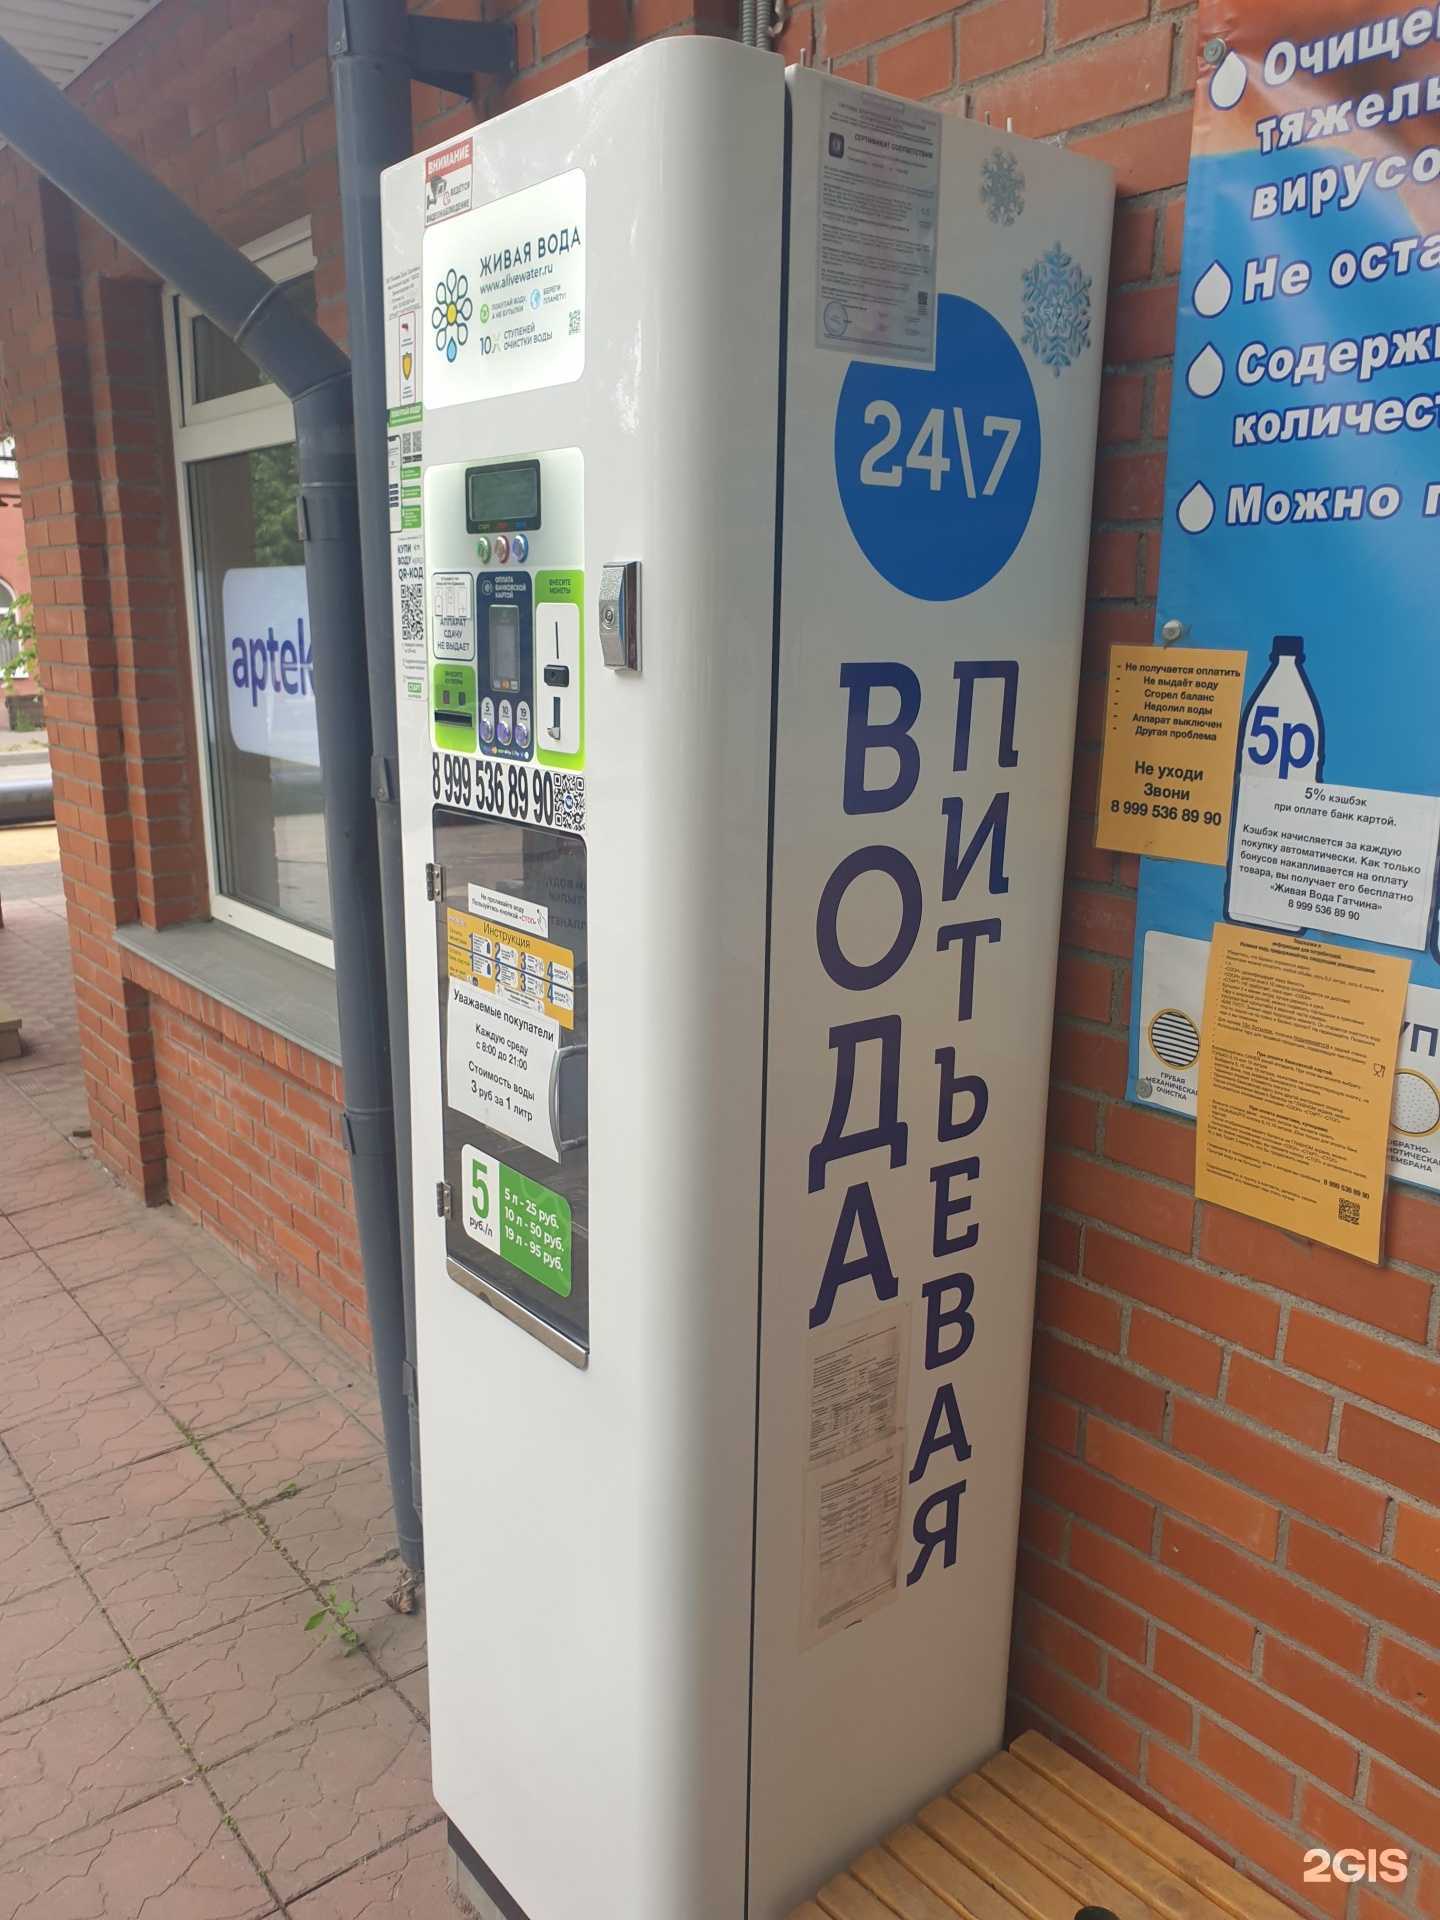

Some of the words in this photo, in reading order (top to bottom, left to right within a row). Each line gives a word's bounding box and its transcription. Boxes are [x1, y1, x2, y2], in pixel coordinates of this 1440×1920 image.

[428, 144, 470, 175] ВНИМАНИЕ
[480, 242, 530, 278] ЖИВАЯ
[538, 227, 581, 257] ВОДА
[480, 263, 553, 294] www.alivewater.ru
[1244, 256, 1310, 302] Не
[504, 321, 535, 339] СТУПЕНЕЙ
[504, 336, 532, 351] ОЧИСТКИ
[533, 331, 552, 343] ВОДЫ
[1233, 395, 1440, 445] количес
[1226, 484, 1400, 524] Можно
[440, 618, 467, 627] АППАРАТ
[443, 630, 462, 639] СДАЧУ
[446, 642, 470, 651] ВЫДАЕТ
[1125, 662, 1137, 672] Не
[1139, 664, 1194, 674] получается
[1196, 667, 1241, 678] оплатить
[1143, 676, 1155, 685] Не
[1196, 681, 1219, 691] воду
[1144, 688, 1178, 699] Сгорел
[1181, 691, 1214, 702] баланс
[1132, 714, 1171, 725] Аппарат
[1173, 718, 1222, 729] выключен
[1187, 706, 1213, 716] воды
[1135, 726, 1168, 737] Другая
[1170, 730, 1217, 741] проблема
[1247, 705, 1316, 780] 5р
[1135, 761, 1154, 775] Не
[1157, 766, 1204, 781] уходи
[433, 752, 441, 800] 8
[444, 754, 472, 807] 999
[476, 760, 505, 815] 536
[508, 765, 528, 820] 89
[533, 769, 554, 826] 90
[1144, 783, 1190, 801] Звони
[1304, 787, 1326, 801] 5%
[1328, 792, 1367, 807] кэшбэк
[1110, 800, 1120, 813] 8
[1123, 801, 1148, 816] 999
[1151, 805, 1178, 820] 536
[1181, 809, 1199, 823] 89
[1204, 812, 1222, 826] 90
[1274, 802, 1292, 815] при
[1293, 805, 1328, 817] оплате
[1330, 809, 1354, 821] банк
[1356, 814, 1397, 827] картой.
[1243, 824, 1278, 838] Кэшбэк
[1281, 832, 1343, 848] начисляется
[1345, 840, 1357, 850] за
[1360, 843, 1402, 857] каждую
[1240, 851, 1278, 864] бонусов
[1280, 859, 1354, 877] накапливается
[1356, 871, 1368, 880] на
[1372, 874, 1408, 888] оплату
[1241, 839, 1278, 853] покупку
[1280, 845, 1357, 864] автоматически.
[1360, 856, 1380, 868] Как
[1383, 862, 1421, 875] только
[1239, 865, 1273, 879] товара,
[1275, 870, 1289, 880] вы
[1291, 875, 1335, 890] получает
[1338, 881, 1355, 892] его
[1358, 885, 1413, 902] бесплатно
[1270, 884, 1307, 898] «Живая
[1309, 890, 1334, 903] Вода
[1336, 894, 1383, 911] Гатчина»
[1287, 899, 1295, 909] 8
[1296, 900, 1313, 912] 999
[1315, 903, 1332, 915] 536
[1334, 907, 1346, 918] 89
[1348, 910, 1360, 921] 90
[483, 922, 531, 949] Инструкция
[808, 662, 923, 1330] ВОДА
[453, 989, 502, 1018] Уважаемые
[504, 1012, 554, 1042] покупатели
[475, 1024, 506, 1044] Каждую
[507, 1039, 529, 1057] среду
[476, 1042, 480, 1050] с
[481, 1041, 497, 1056] 8:00
[498, 1052, 507, 1062] до
[509, 1054, 528, 1071] 21:00
[468, 1061, 512, 1089] Стоимость
[514, 1084, 535, 1101] воды
[1160, 1072, 1185, 1084] ГРУБАЯ
[471, 1080, 477, 1093] 3
[479, 1086, 493, 1102] руб
[494, 1097, 503, 1106] за
[506, 1096, 511, 1110] 1
[514, 1105, 533, 1122] литр
[1156, 1086, 1187, 1100] ОЧИСТКА
[906, 660, 1019, 1587] ПИТЬЕВАЯ
[1389, 1147, 1440, 1166] ОТИЧЕСКА
[1390, 1139, 1431, 1154] БРАТНО-
[472, 1158, 490, 1219] 5
[504, 1188, 511, 1200] 5
[512, 1194, 518, 1205] л
[526, 1200, 537, 1216] 25
[538, 1209, 559, 1229] руб.
[469, 1216, 493, 1237] руб./л
[504, 1206, 515, 1221] 10
[516, 1215, 522, 1226] л
[530, 1223, 542, 1238] 50
[543, 1232, 564, 1252] руб.
[505, 1225, 515, 1241] 19
[516, 1235, 522, 1246] л
[529, 1241, 542, 1258] 95
[543, 1251, 564, 1272] руб.
